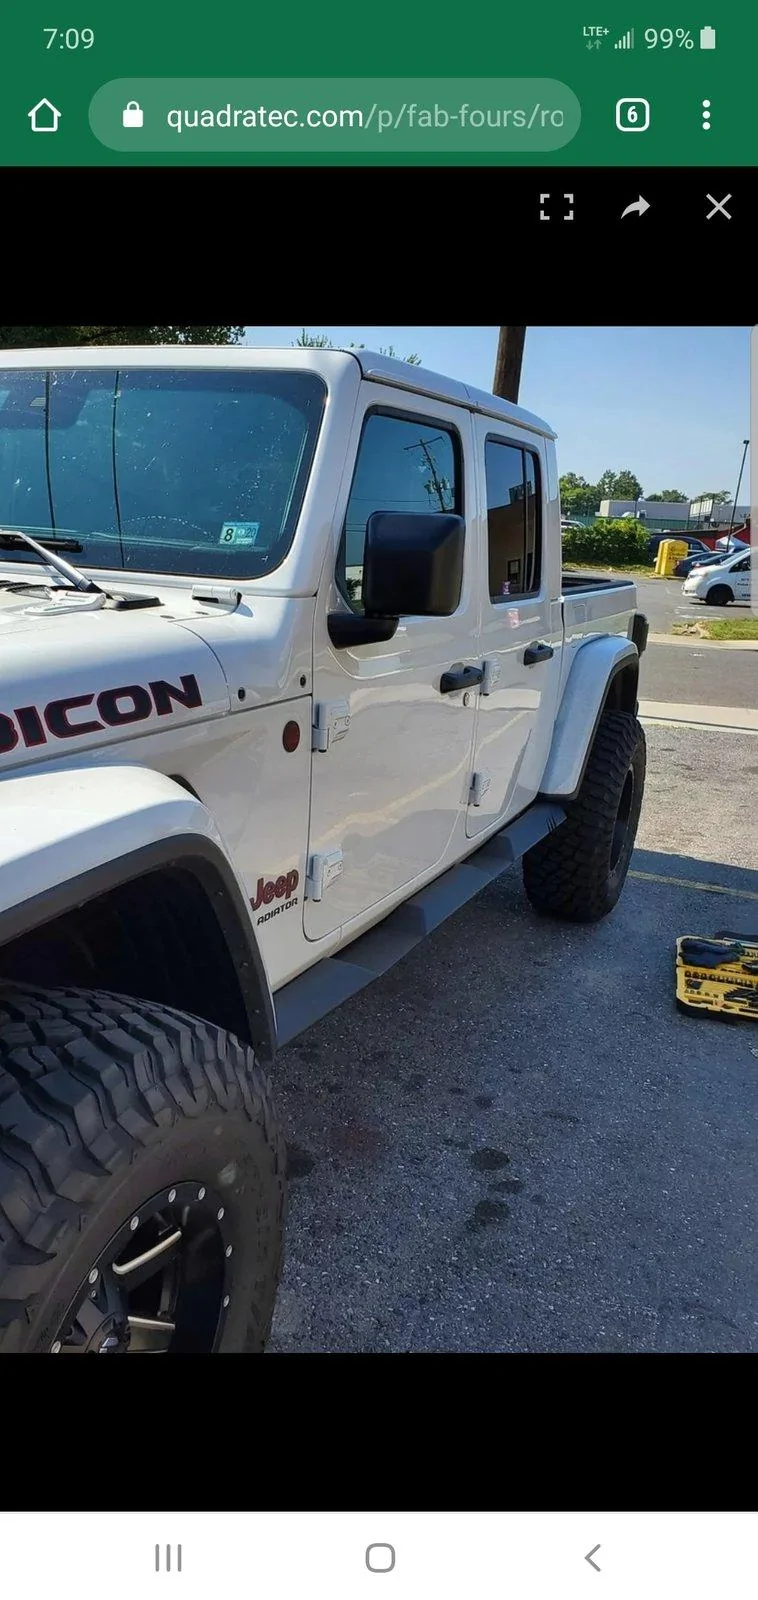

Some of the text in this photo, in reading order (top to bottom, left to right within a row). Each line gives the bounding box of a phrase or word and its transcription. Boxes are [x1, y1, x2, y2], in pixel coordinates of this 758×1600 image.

[43, 28, 95, 50] 7:09
[583, 26, 610, 37] LTE+
[644, 28, 694, 50] 99%
[627, 105, 638, 123] 6
[224, 528, 234, 542] 8
[249, 869, 299, 912] Jeep
[256, 897, 298, 926] ADIATOR
